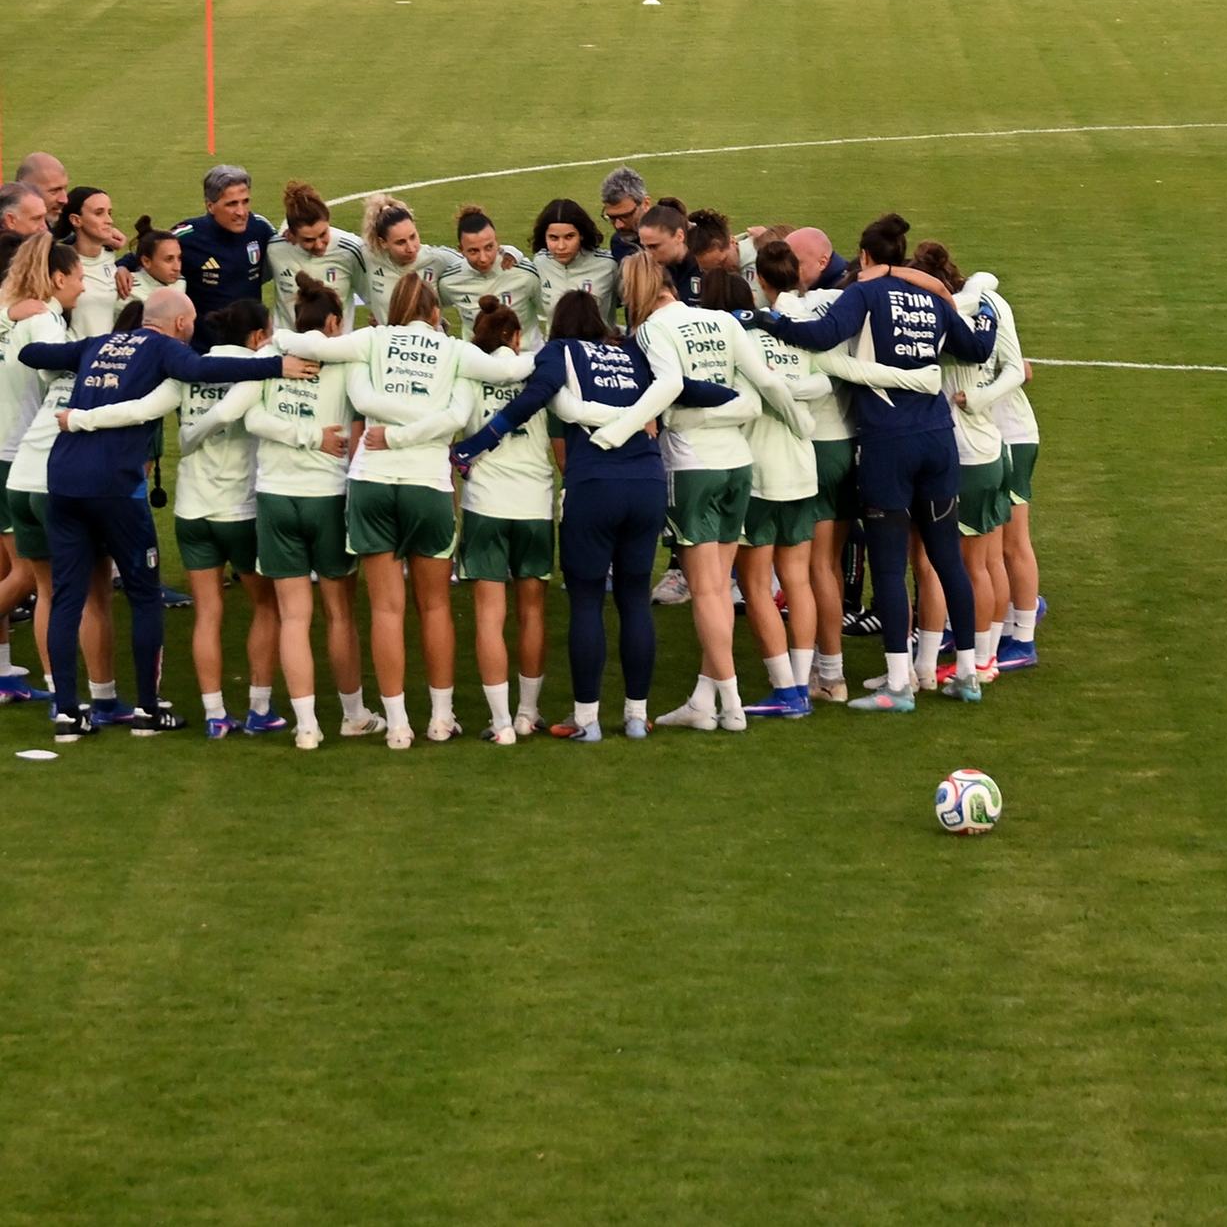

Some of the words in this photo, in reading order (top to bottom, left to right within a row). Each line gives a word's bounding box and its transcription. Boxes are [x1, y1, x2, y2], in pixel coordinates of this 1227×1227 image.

[904, 292, 934, 308] TIM
[890, 305, 937, 324] Poste
[692, 320, 722, 334] TIM
[410, 334, 440, 350] TIM
[686, 339, 726, 355] Poste
[387, 346, 438, 365] Poste
[765, 350, 799, 365] Pose
[384, 379, 410, 394] eni
[594, 375, 619, 389] eni
[190, 383, 229, 401] Post
[278, 402, 298, 415] eni
